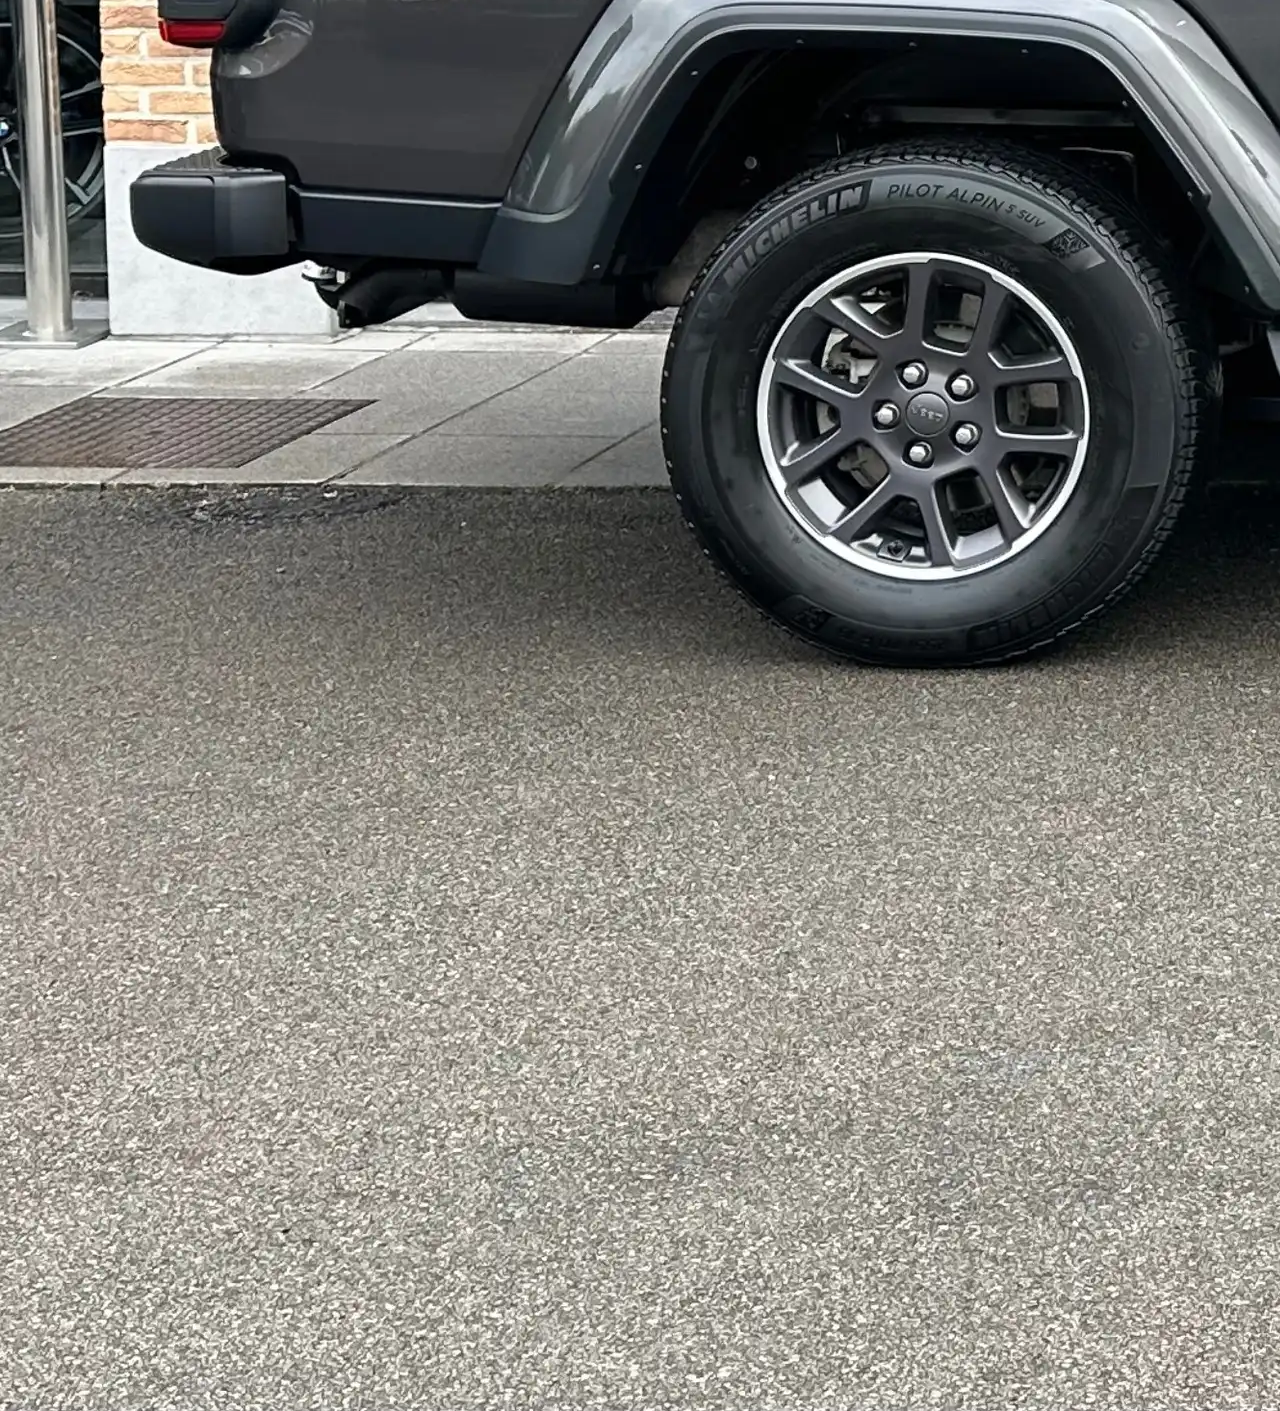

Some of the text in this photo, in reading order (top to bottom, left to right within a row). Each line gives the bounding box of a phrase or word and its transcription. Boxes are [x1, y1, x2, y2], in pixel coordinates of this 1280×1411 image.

[722, 186, 864, 288] MICHELIN
[886, 184, 944, 199] PILOT
[945, 187, 1006, 213] ALPIN
[1016, 209, 1046, 228] SUV
